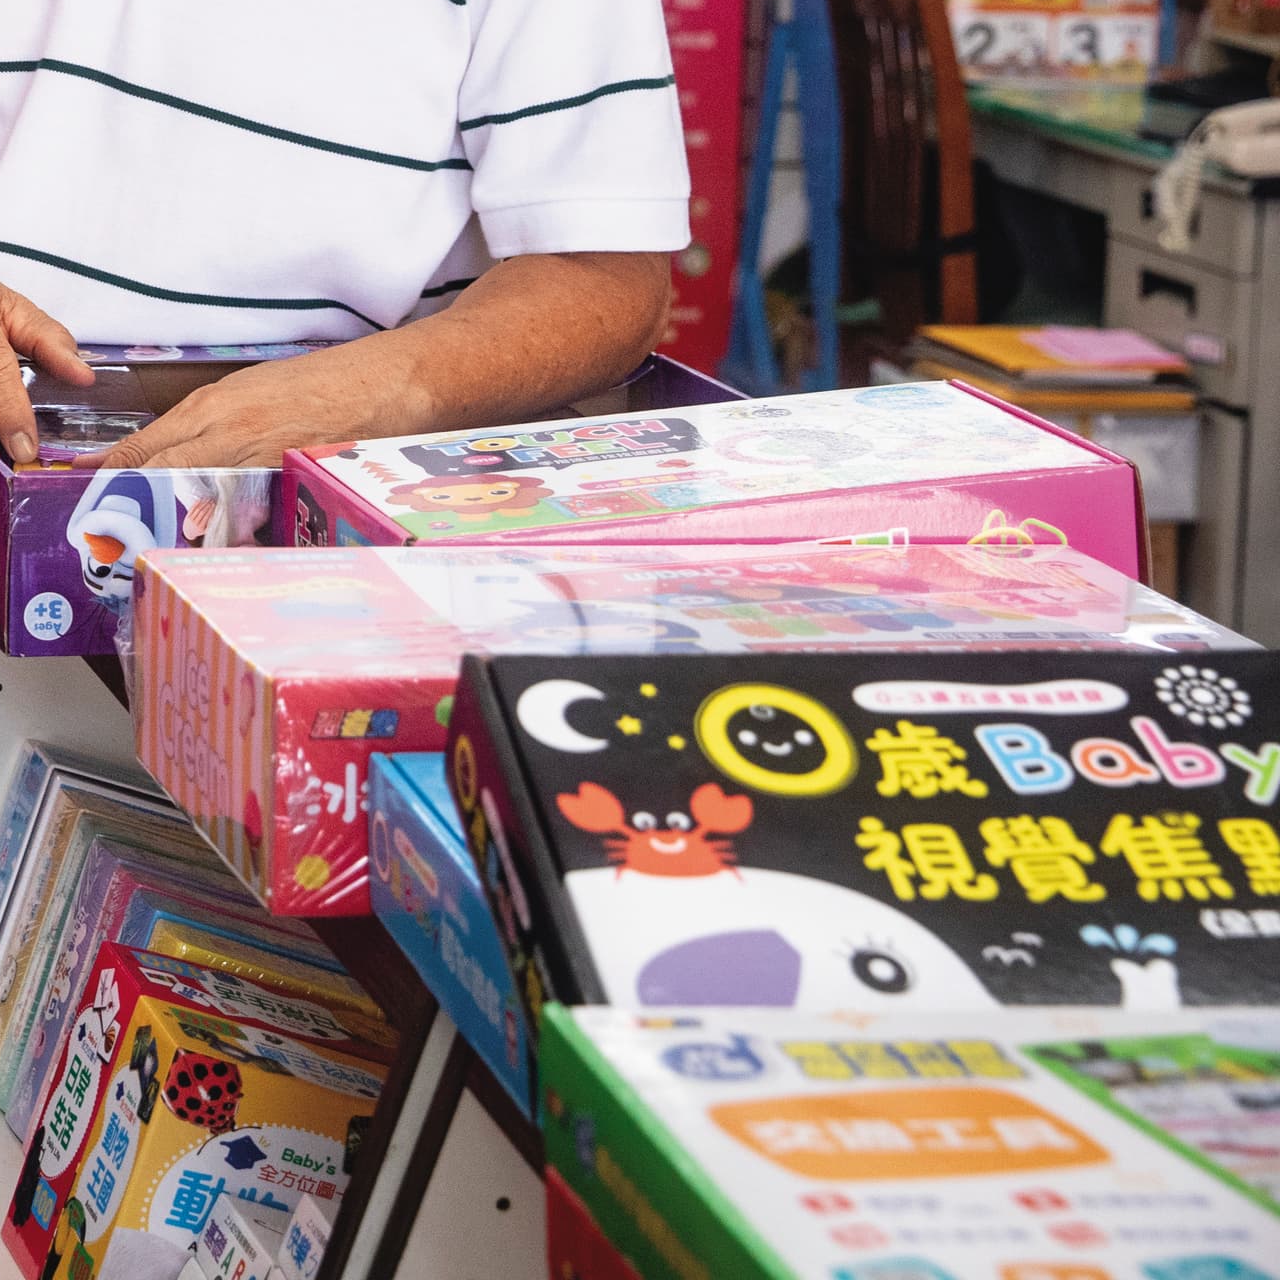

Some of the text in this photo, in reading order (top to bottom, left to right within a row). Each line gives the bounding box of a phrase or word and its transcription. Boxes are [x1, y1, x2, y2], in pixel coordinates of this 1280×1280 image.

[422, 418, 672, 458] TOUCH
[506, 437, 671, 464] FEEL
[34, 599, 64, 620] 3+
[280, 1146, 338, 1177] Baby's
